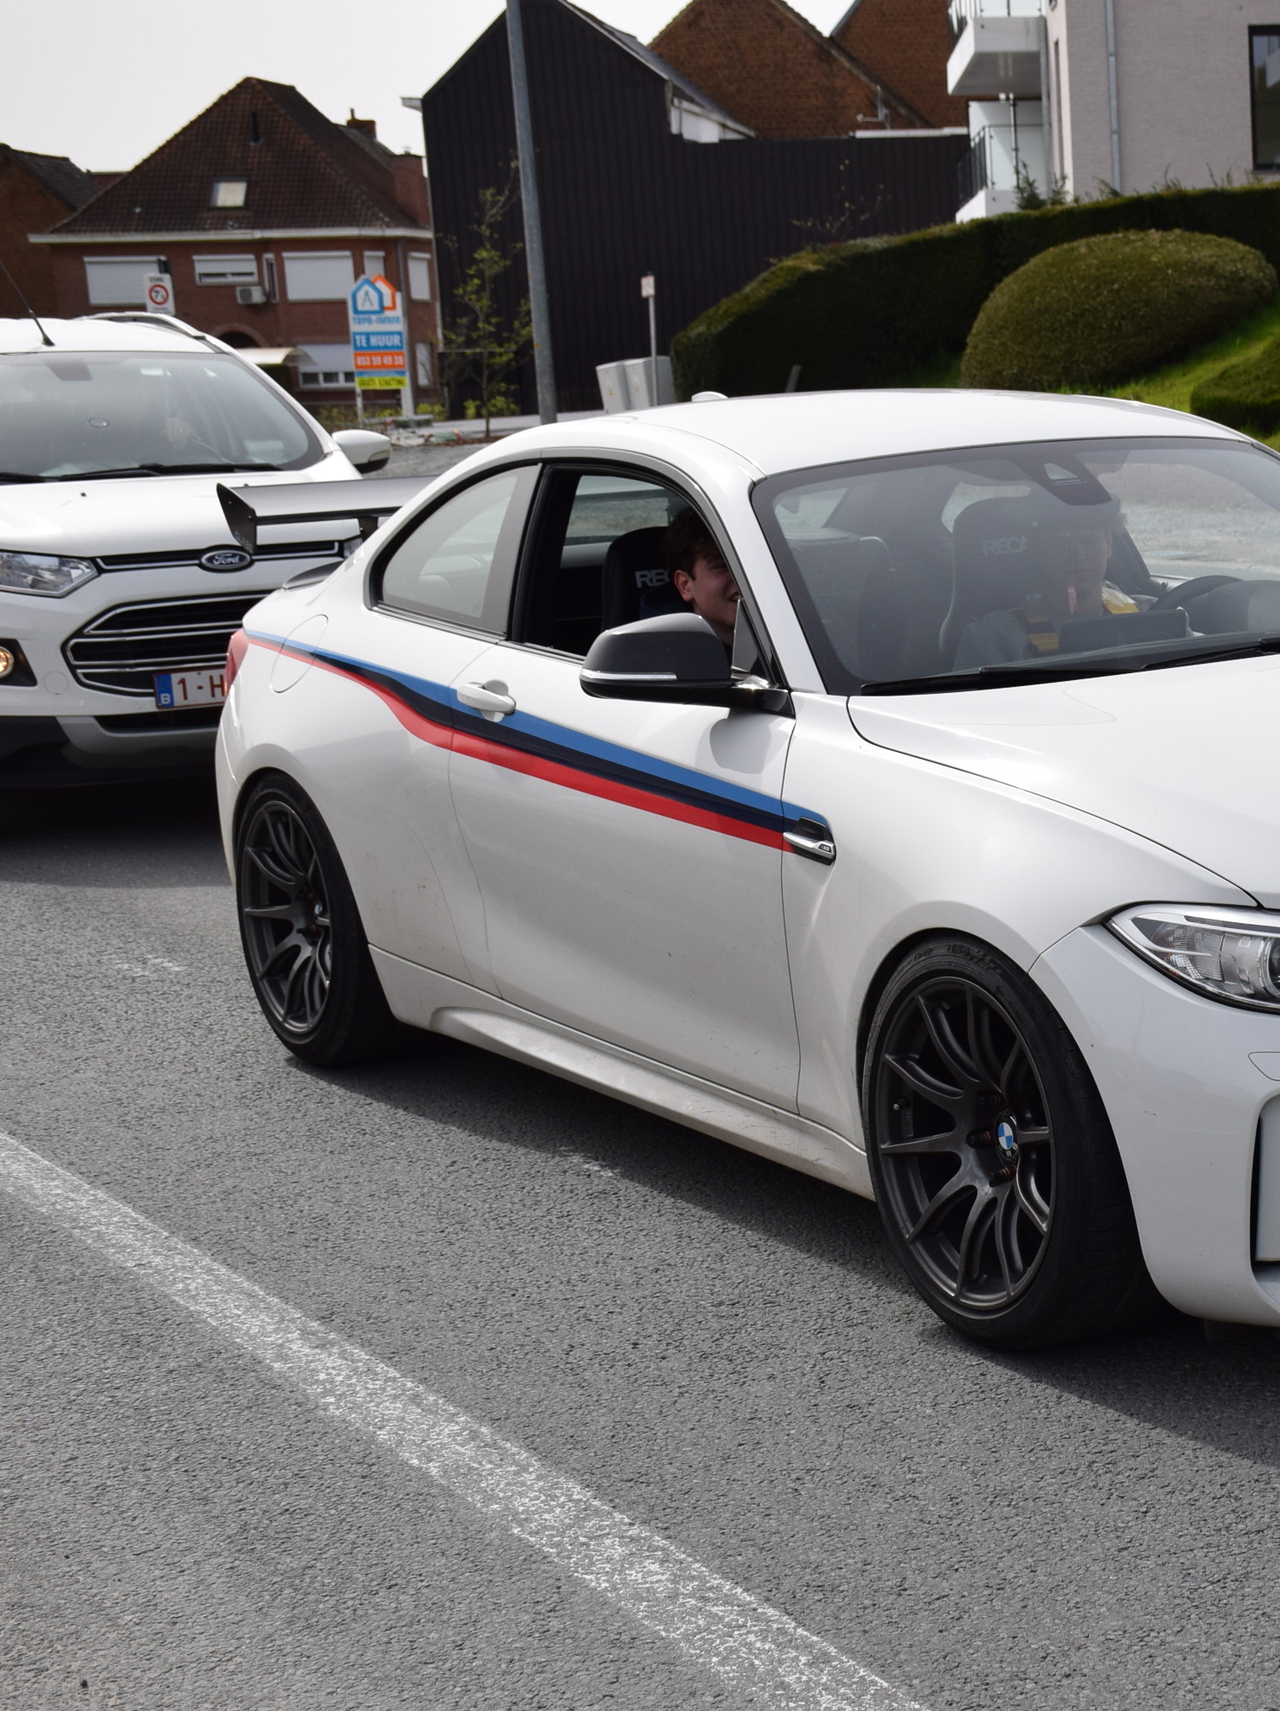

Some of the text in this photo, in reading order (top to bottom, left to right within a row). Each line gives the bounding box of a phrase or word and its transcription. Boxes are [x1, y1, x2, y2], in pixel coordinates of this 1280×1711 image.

[355, 334, 402, 347] TE HUUR
[213, 554, 240, 565] Ford
[160, 693, 171, 705] B
